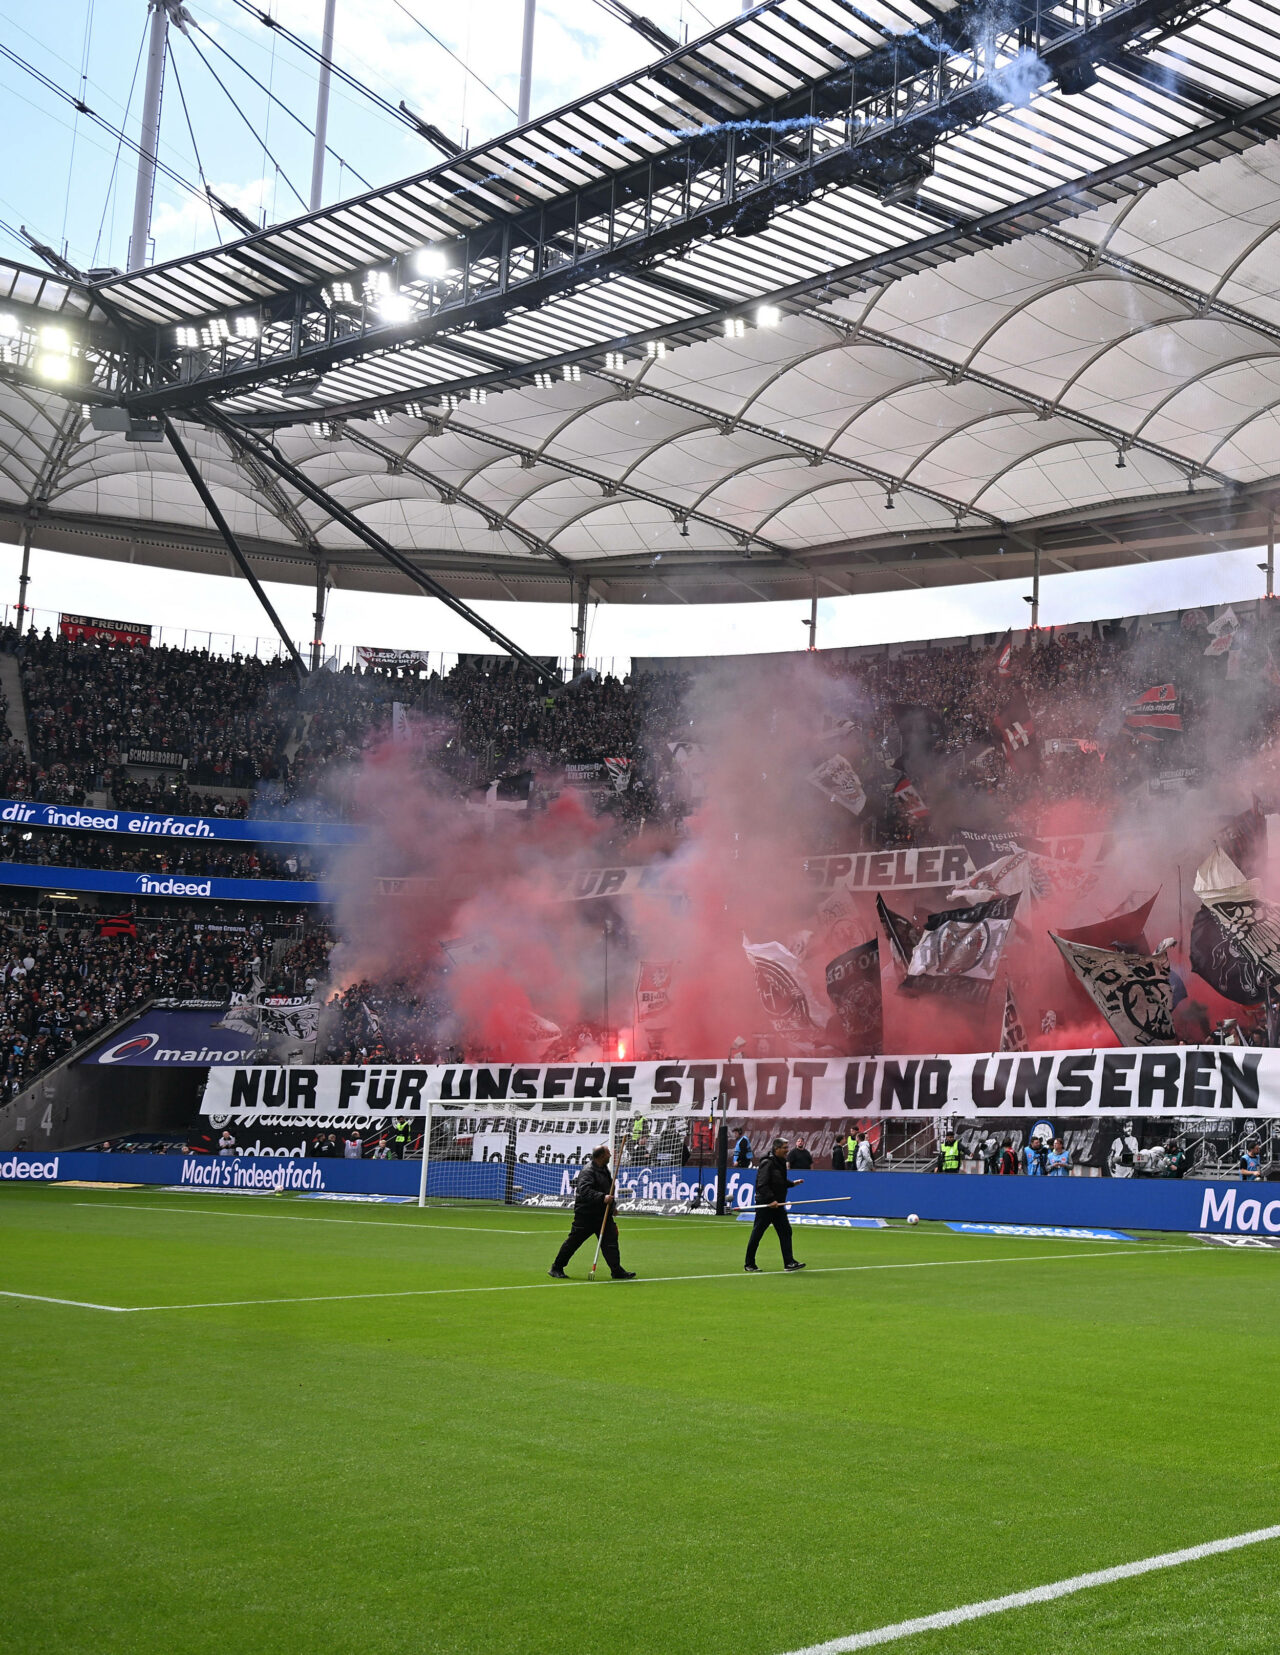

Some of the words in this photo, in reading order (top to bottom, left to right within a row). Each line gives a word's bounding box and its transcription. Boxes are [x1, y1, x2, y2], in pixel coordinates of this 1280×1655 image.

[62, 615, 87, 624] SGE
[91, 619, 148, 634] FREUNDE
[2, 804, 35, 822] dir
[43, 806, 118, 830] indeed
[128, 816, 215, 837] einfach.
[136, 875, 211, 896] indeed
[230, 1069, 318, 1109] NUR
[339, 1069, 429, 1111] FÜR
[439, 1066, 636, 1112] UNSERE
[650, 1061, 829, 1111] STADT
[844, 1059, 952, 1110] UND
[971, 1051, 1262, 1109] UNSEREN
[41, 1104, 53, 1136] 4
[181, 1158, 231, 1185] Mach's
